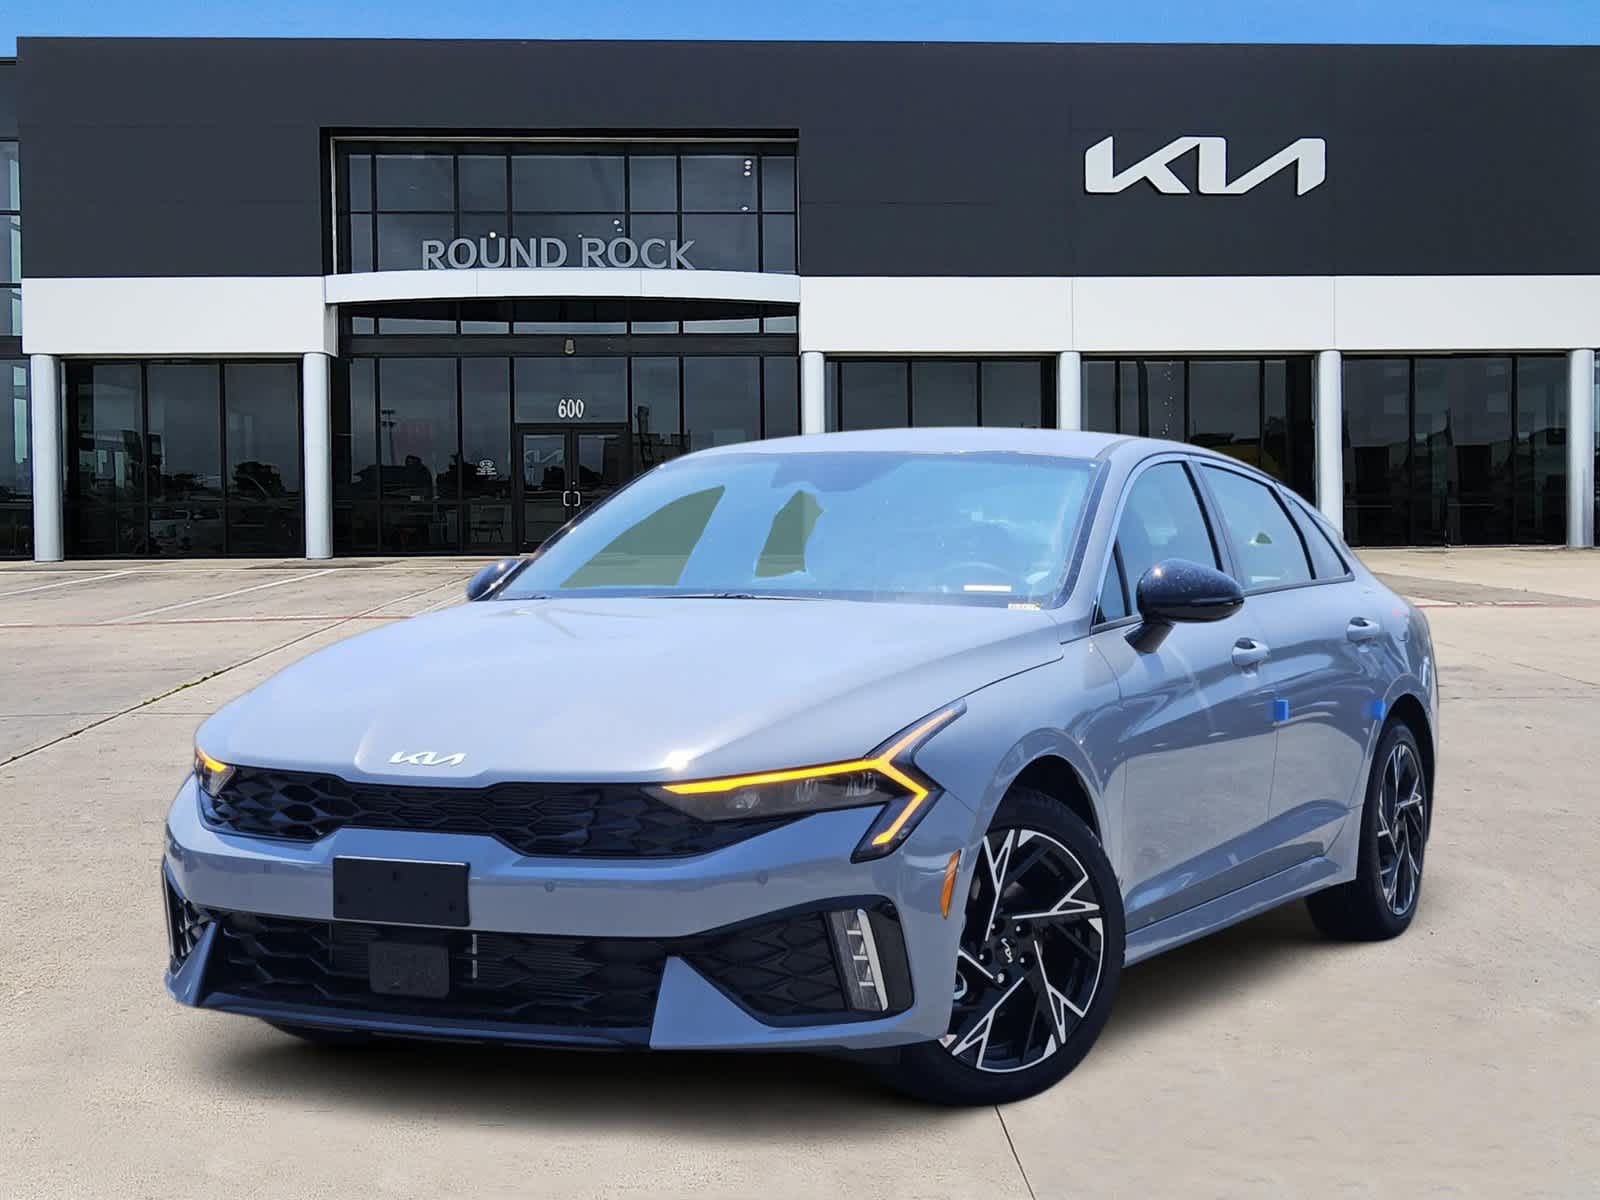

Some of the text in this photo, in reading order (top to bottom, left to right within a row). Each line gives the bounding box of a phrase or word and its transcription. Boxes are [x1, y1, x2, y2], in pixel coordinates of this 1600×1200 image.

[1085, 135, 1326, 196] KIA
[422, 238, 696, 269] ROUND ROCK
[558, 399, 584, 418] 600
[389, 751, 466, 767] KIA
